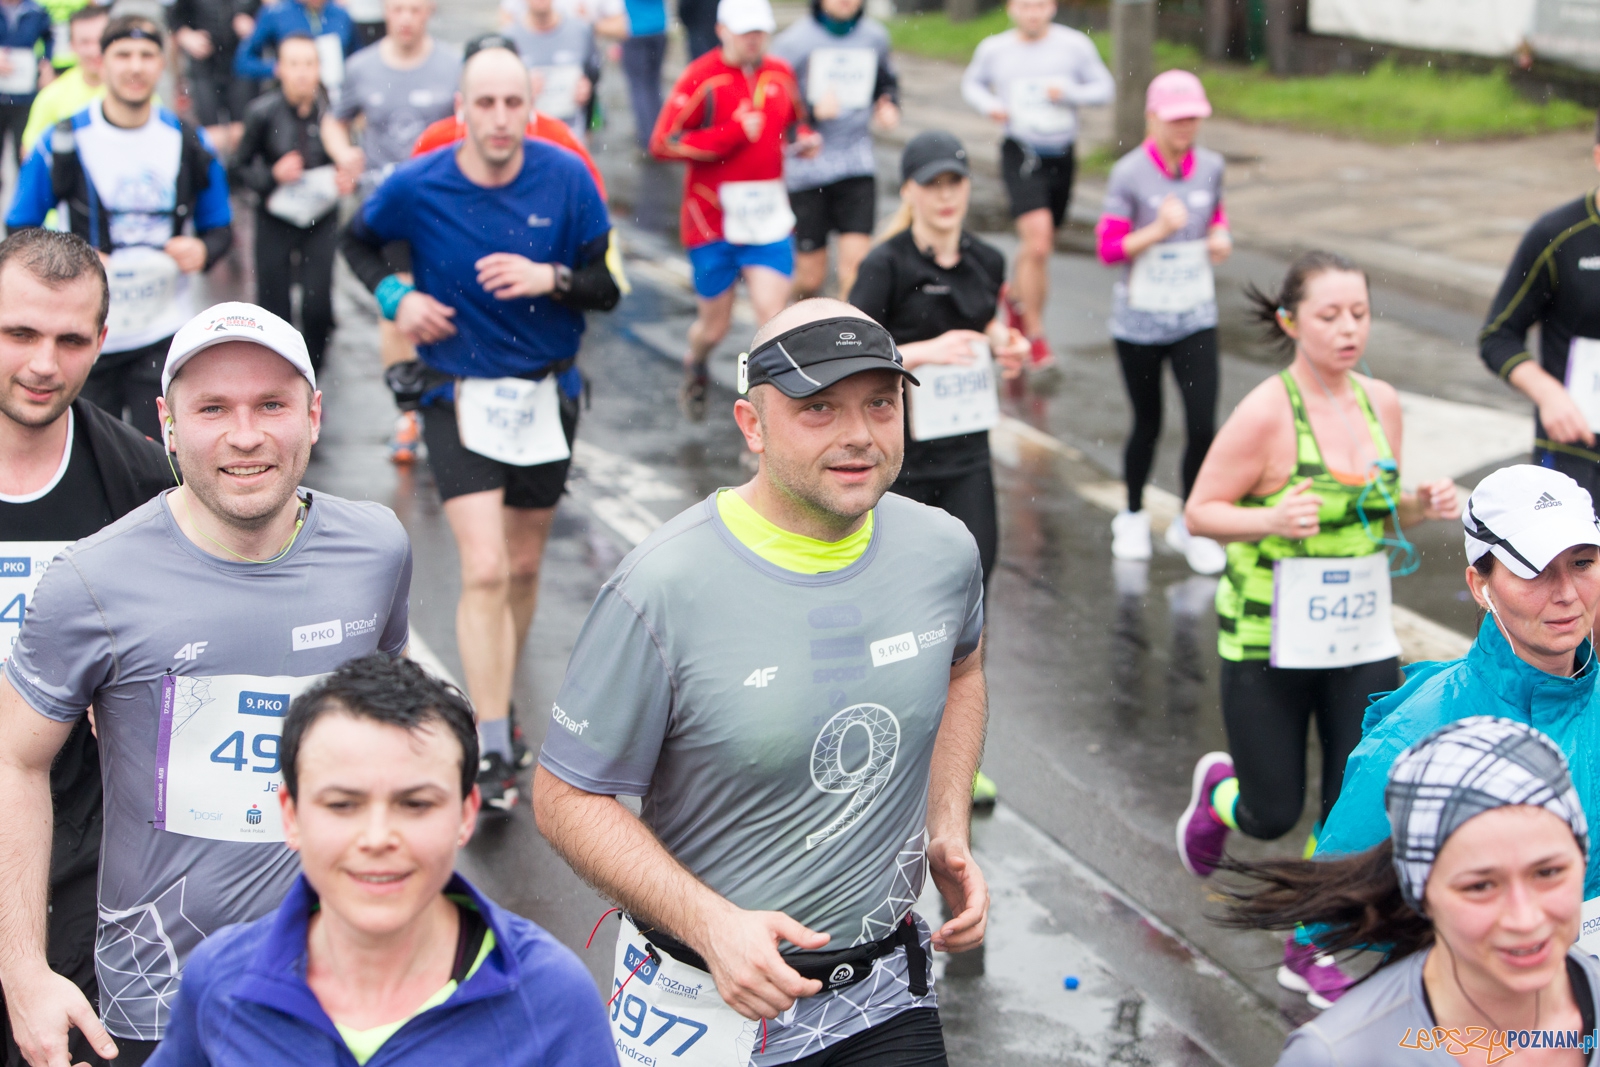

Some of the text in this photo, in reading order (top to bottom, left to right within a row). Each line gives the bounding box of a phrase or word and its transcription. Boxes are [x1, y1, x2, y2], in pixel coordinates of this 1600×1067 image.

[1534, 501, 1562, 511] adidas
[3, 562, 25, 573] PKO
[1308, 590, 1377, 621] 6423
[300, 628, 335, 643] 9. PKO
[174, 641, 208, 660] 4F
[878, 641, 910, 658] 9. PKO
[743, 666, 778, 688] 4F
[246, 698, 282, 711] 9. PKO
[807, 702, 900, 850] 9
[615, 1038, 657, 1067] Andrzej
